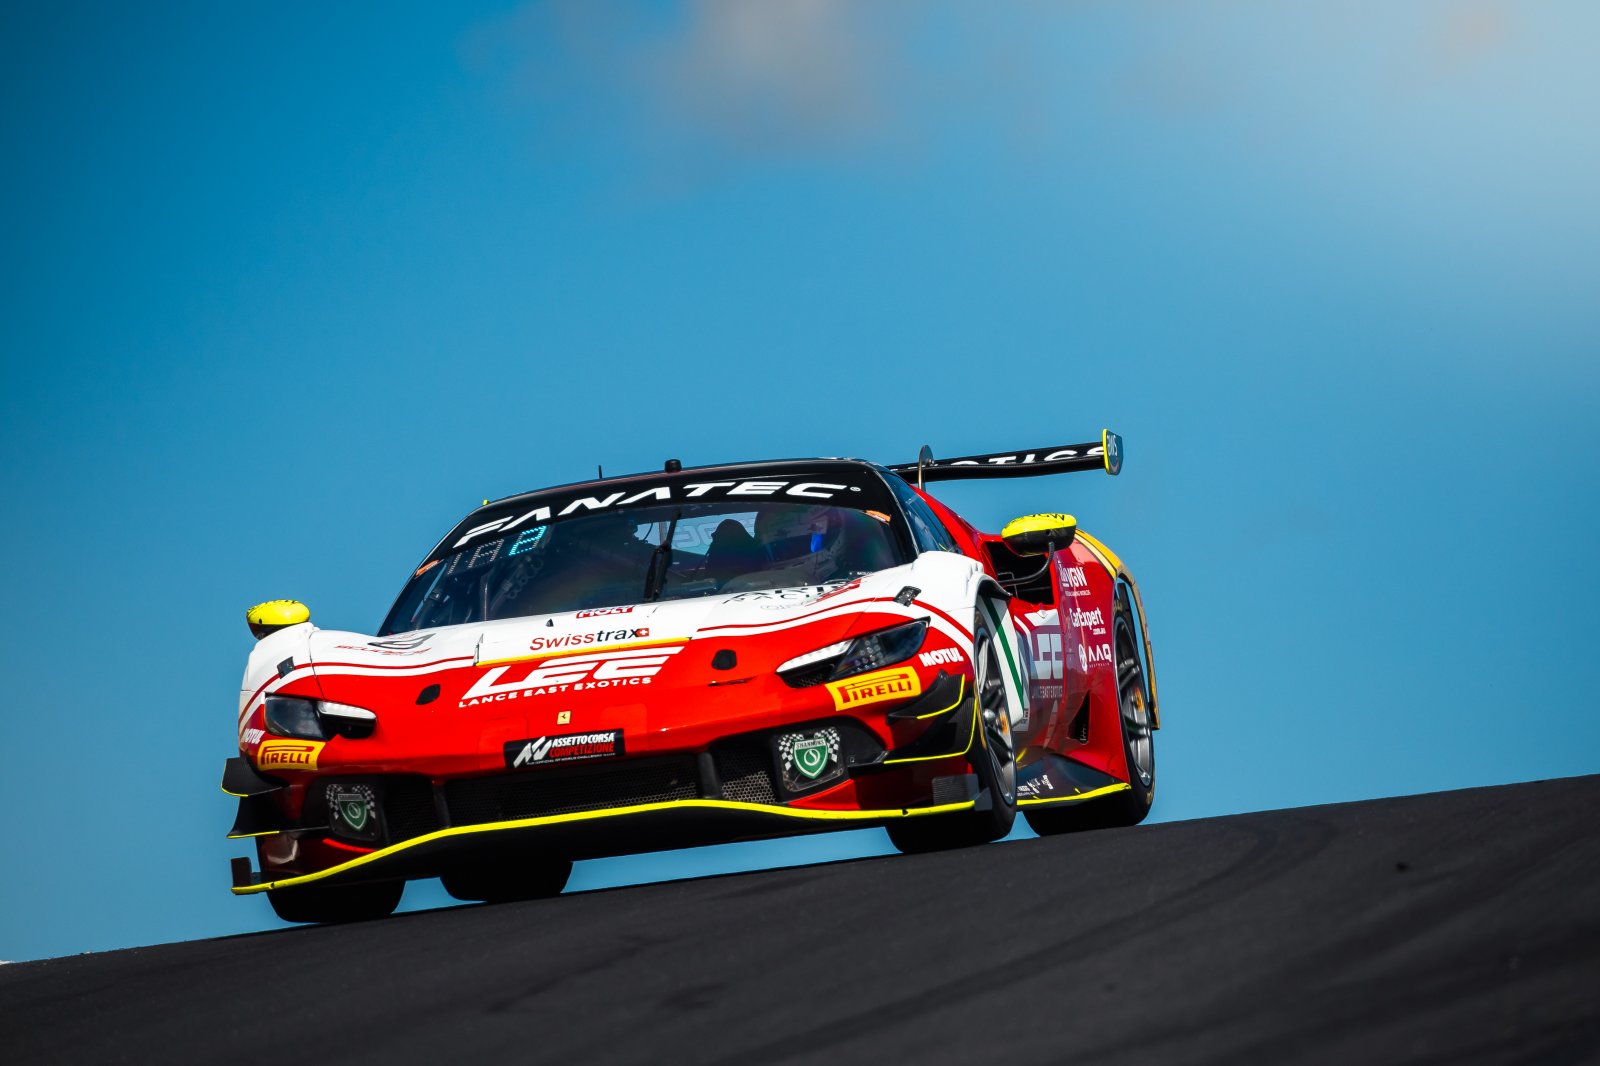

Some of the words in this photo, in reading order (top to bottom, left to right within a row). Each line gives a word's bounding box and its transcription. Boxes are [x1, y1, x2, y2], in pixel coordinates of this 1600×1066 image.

[453, 481, 847, 548] FANATEC
[1069, 607, 1104, 630] CarExpert
[530, 628, 639, 650] Swisstrax
[919, 647, 964, 667] MOTUL
[458, 692, 518, 708] LANCE
[523, 685, 569, 697] EAST
[574, 677, 652, 691] EXOTICS
[837, 674, 912, 703] PIRELLI
[549, 743, 614, 758] COMPETIZIONE
[552, 735, 587, 748] ASSETTO
[587, 732, 615, 745] CORSA
[261, 746, 315, 766] PIRELLI
